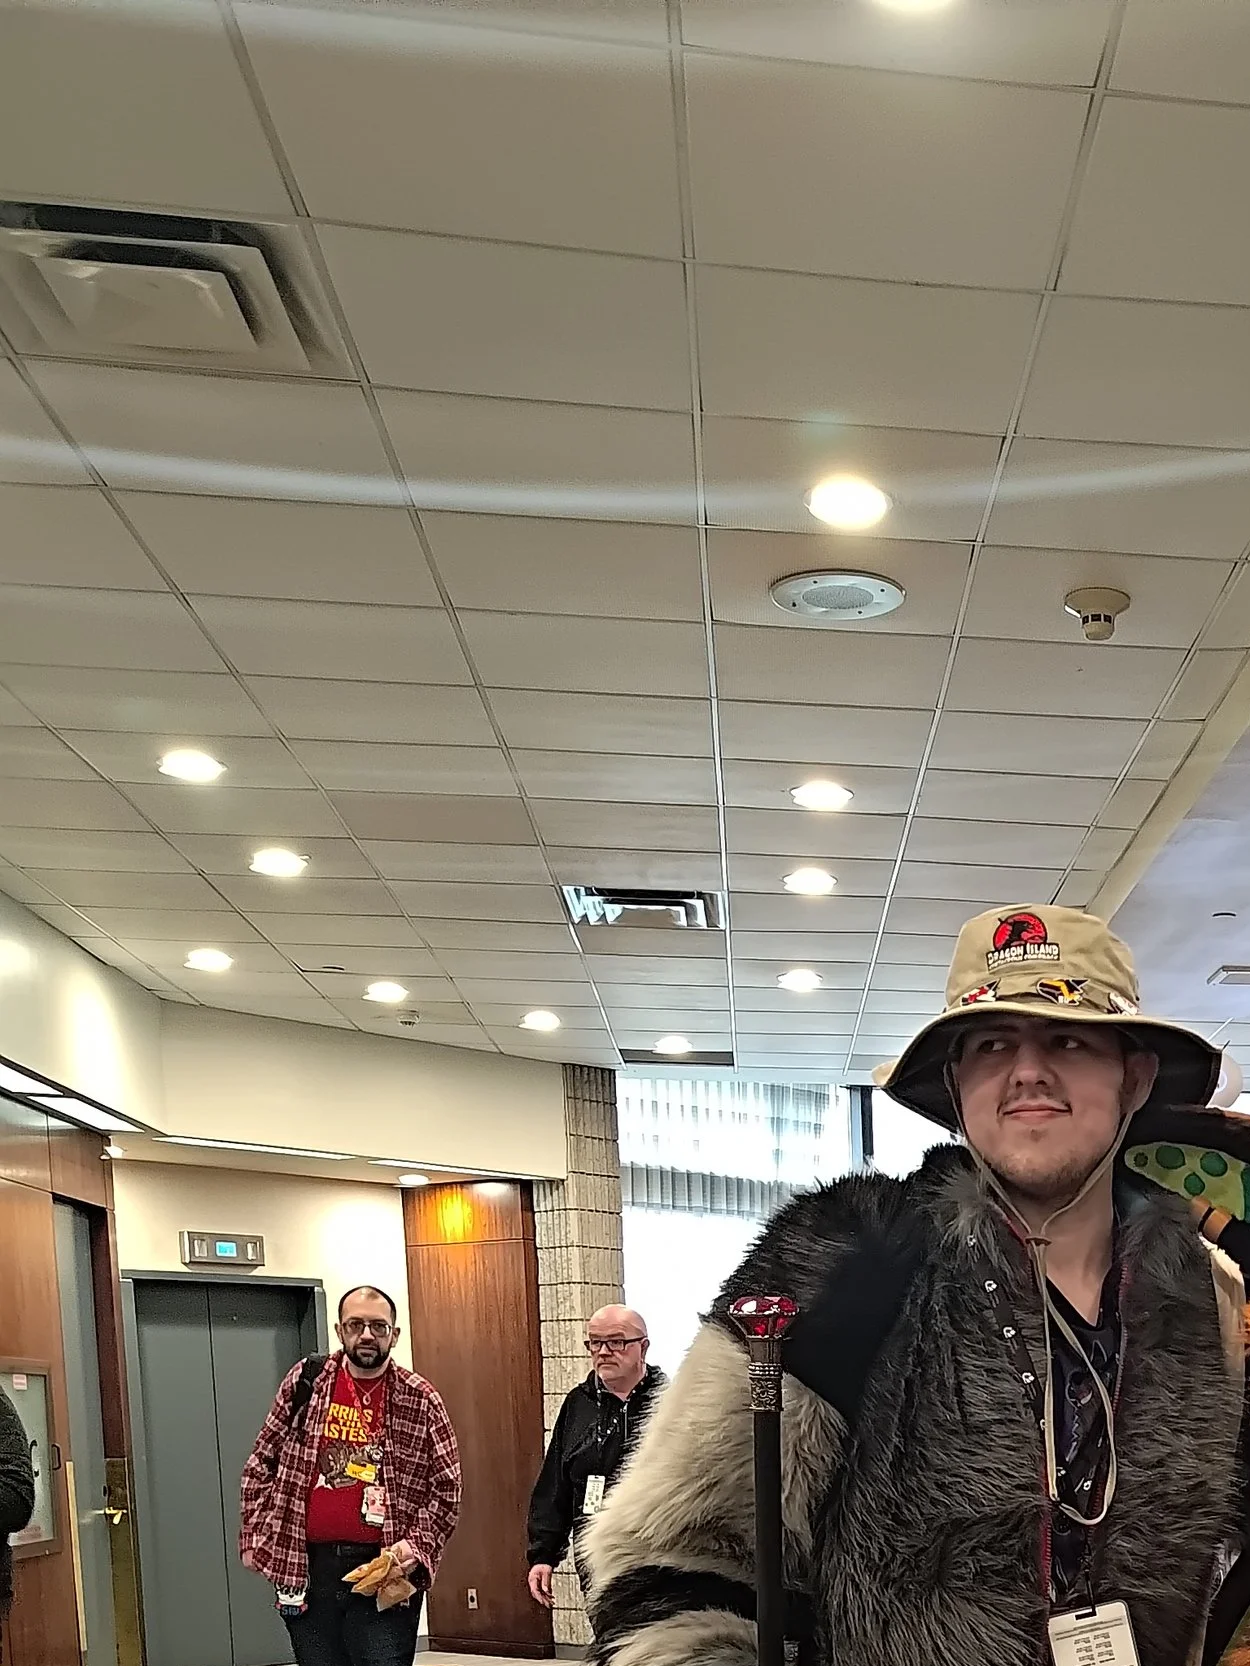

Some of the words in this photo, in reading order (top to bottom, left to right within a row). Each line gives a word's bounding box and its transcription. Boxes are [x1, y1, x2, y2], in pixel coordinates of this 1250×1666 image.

[987, 945, 1024, 965] DRAGON
[1026, 943, 1059, 955] ISLAND
[328, 1402, 374, 1423] RRIES
